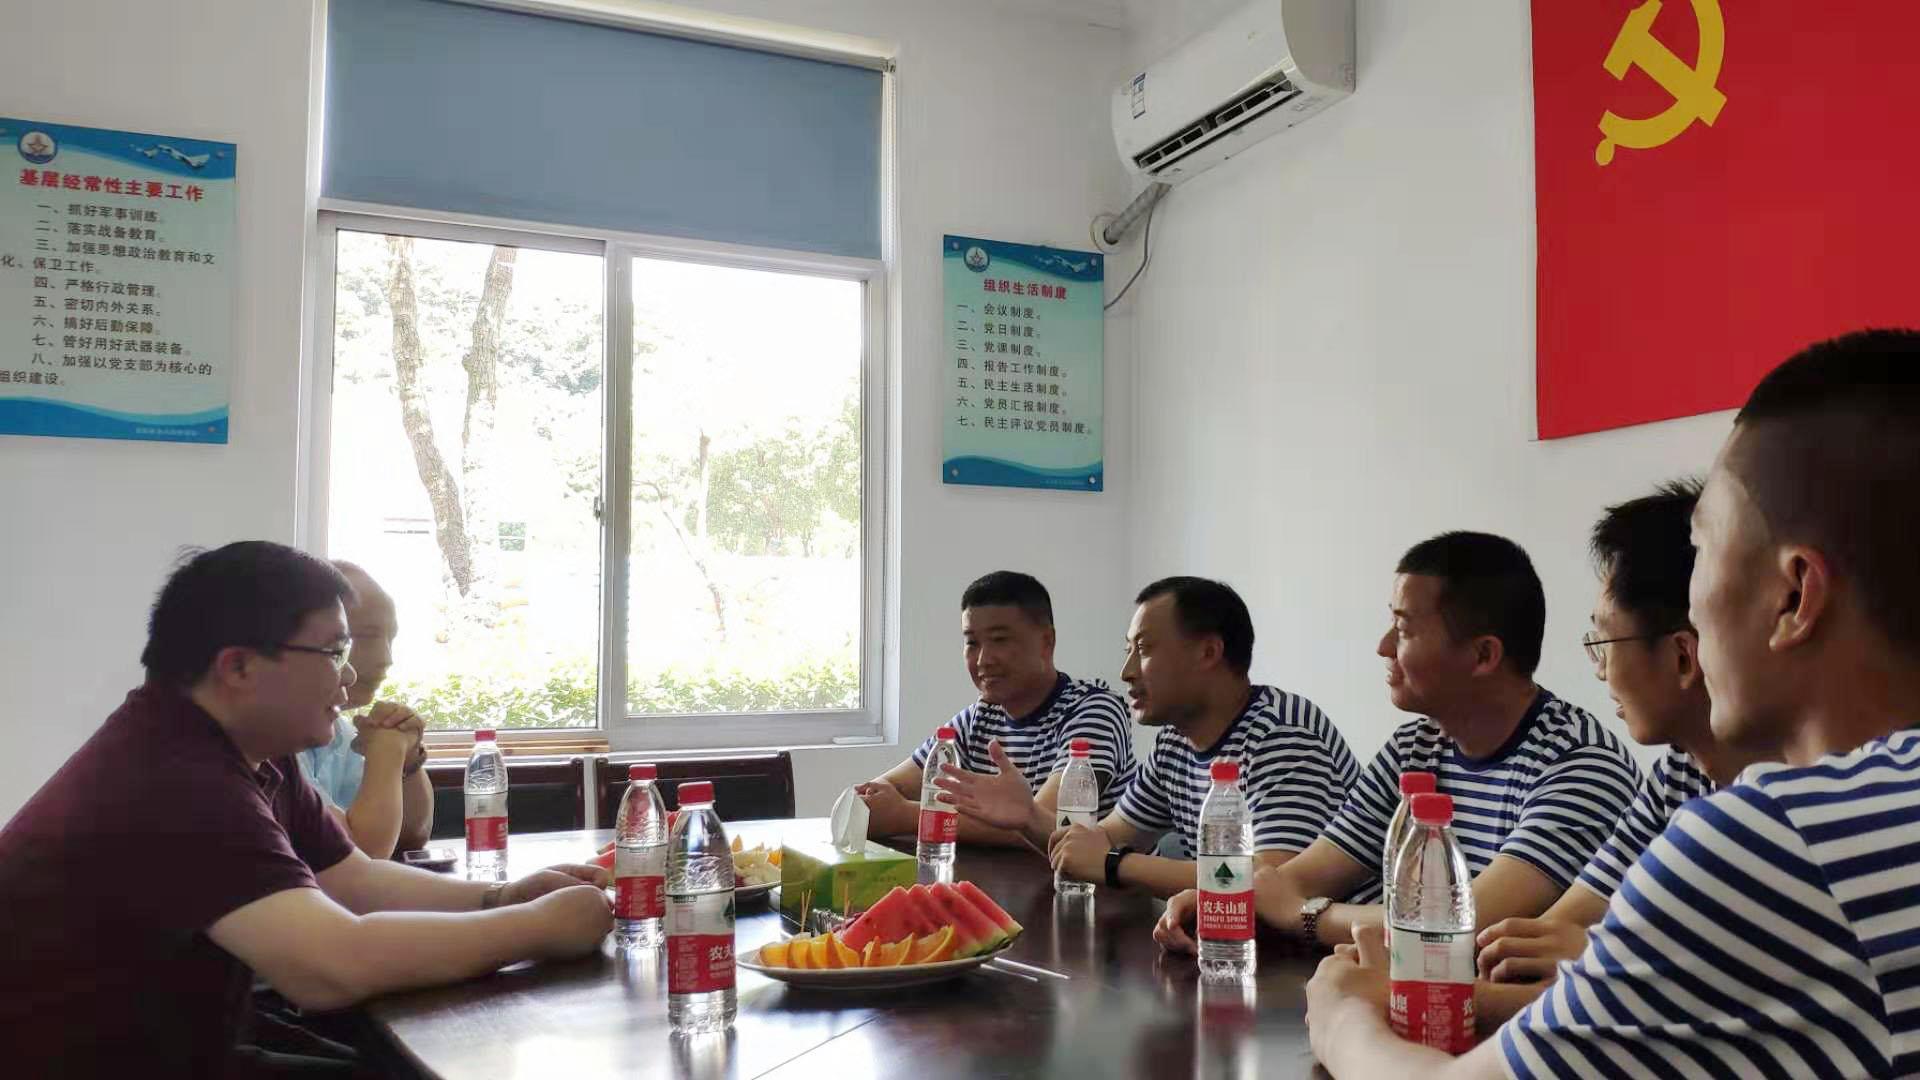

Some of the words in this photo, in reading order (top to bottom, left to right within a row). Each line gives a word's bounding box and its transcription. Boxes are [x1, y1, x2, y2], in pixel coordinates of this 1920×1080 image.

[20, 168, 204, 202] 基层经常性主要工作
[983, 279, 1067, 301] 组织生活制度
[1203, 900, 1247, 915] 农夫山泉
